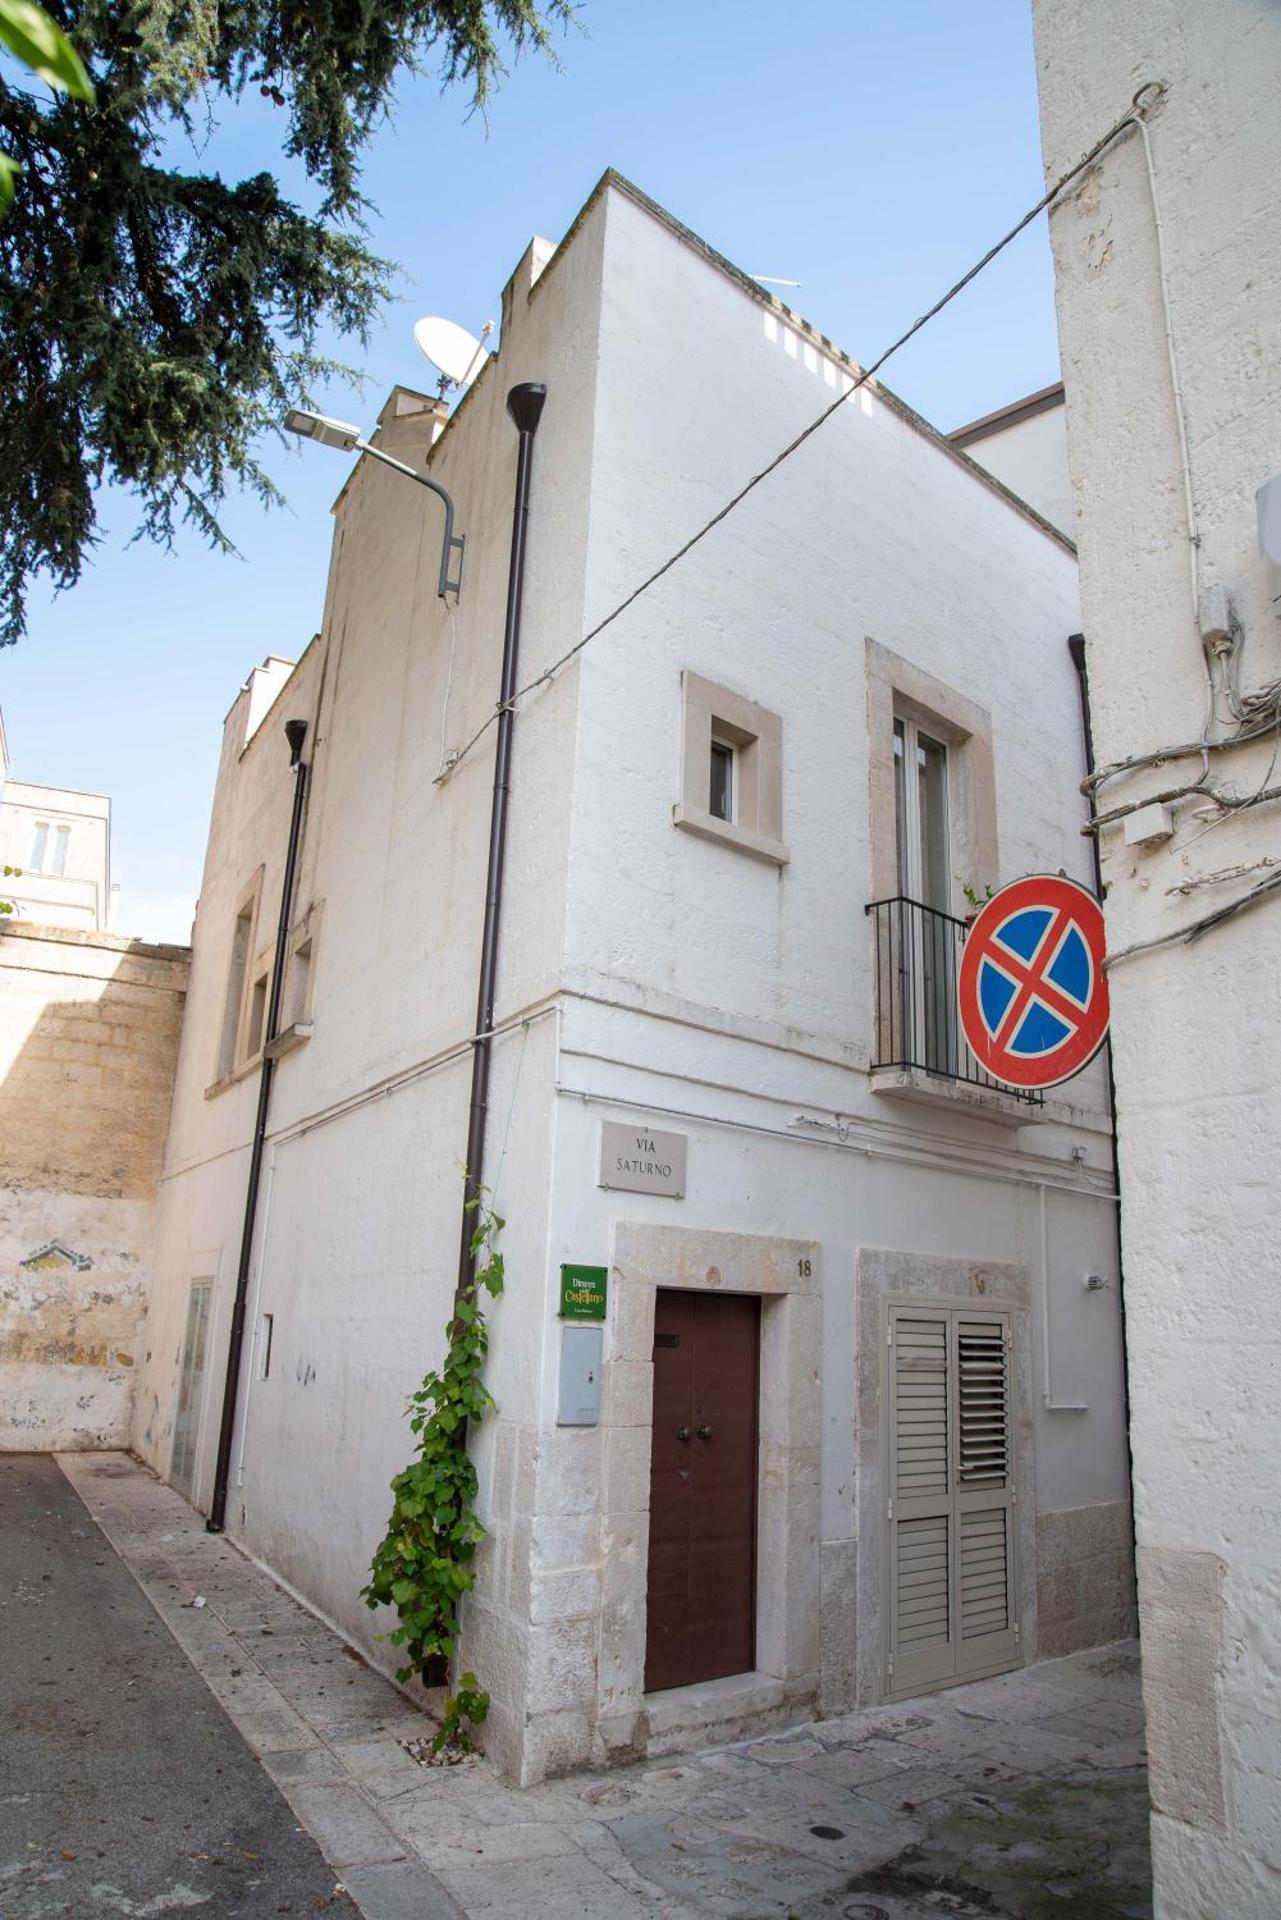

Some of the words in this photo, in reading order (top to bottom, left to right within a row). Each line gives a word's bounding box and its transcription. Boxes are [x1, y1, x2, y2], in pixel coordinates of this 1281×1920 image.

[635, 1138, 656, 1153] VIA
[616, 1158, 672, 1178] SATURNO
[798, 1259, 812, 1277] 18
